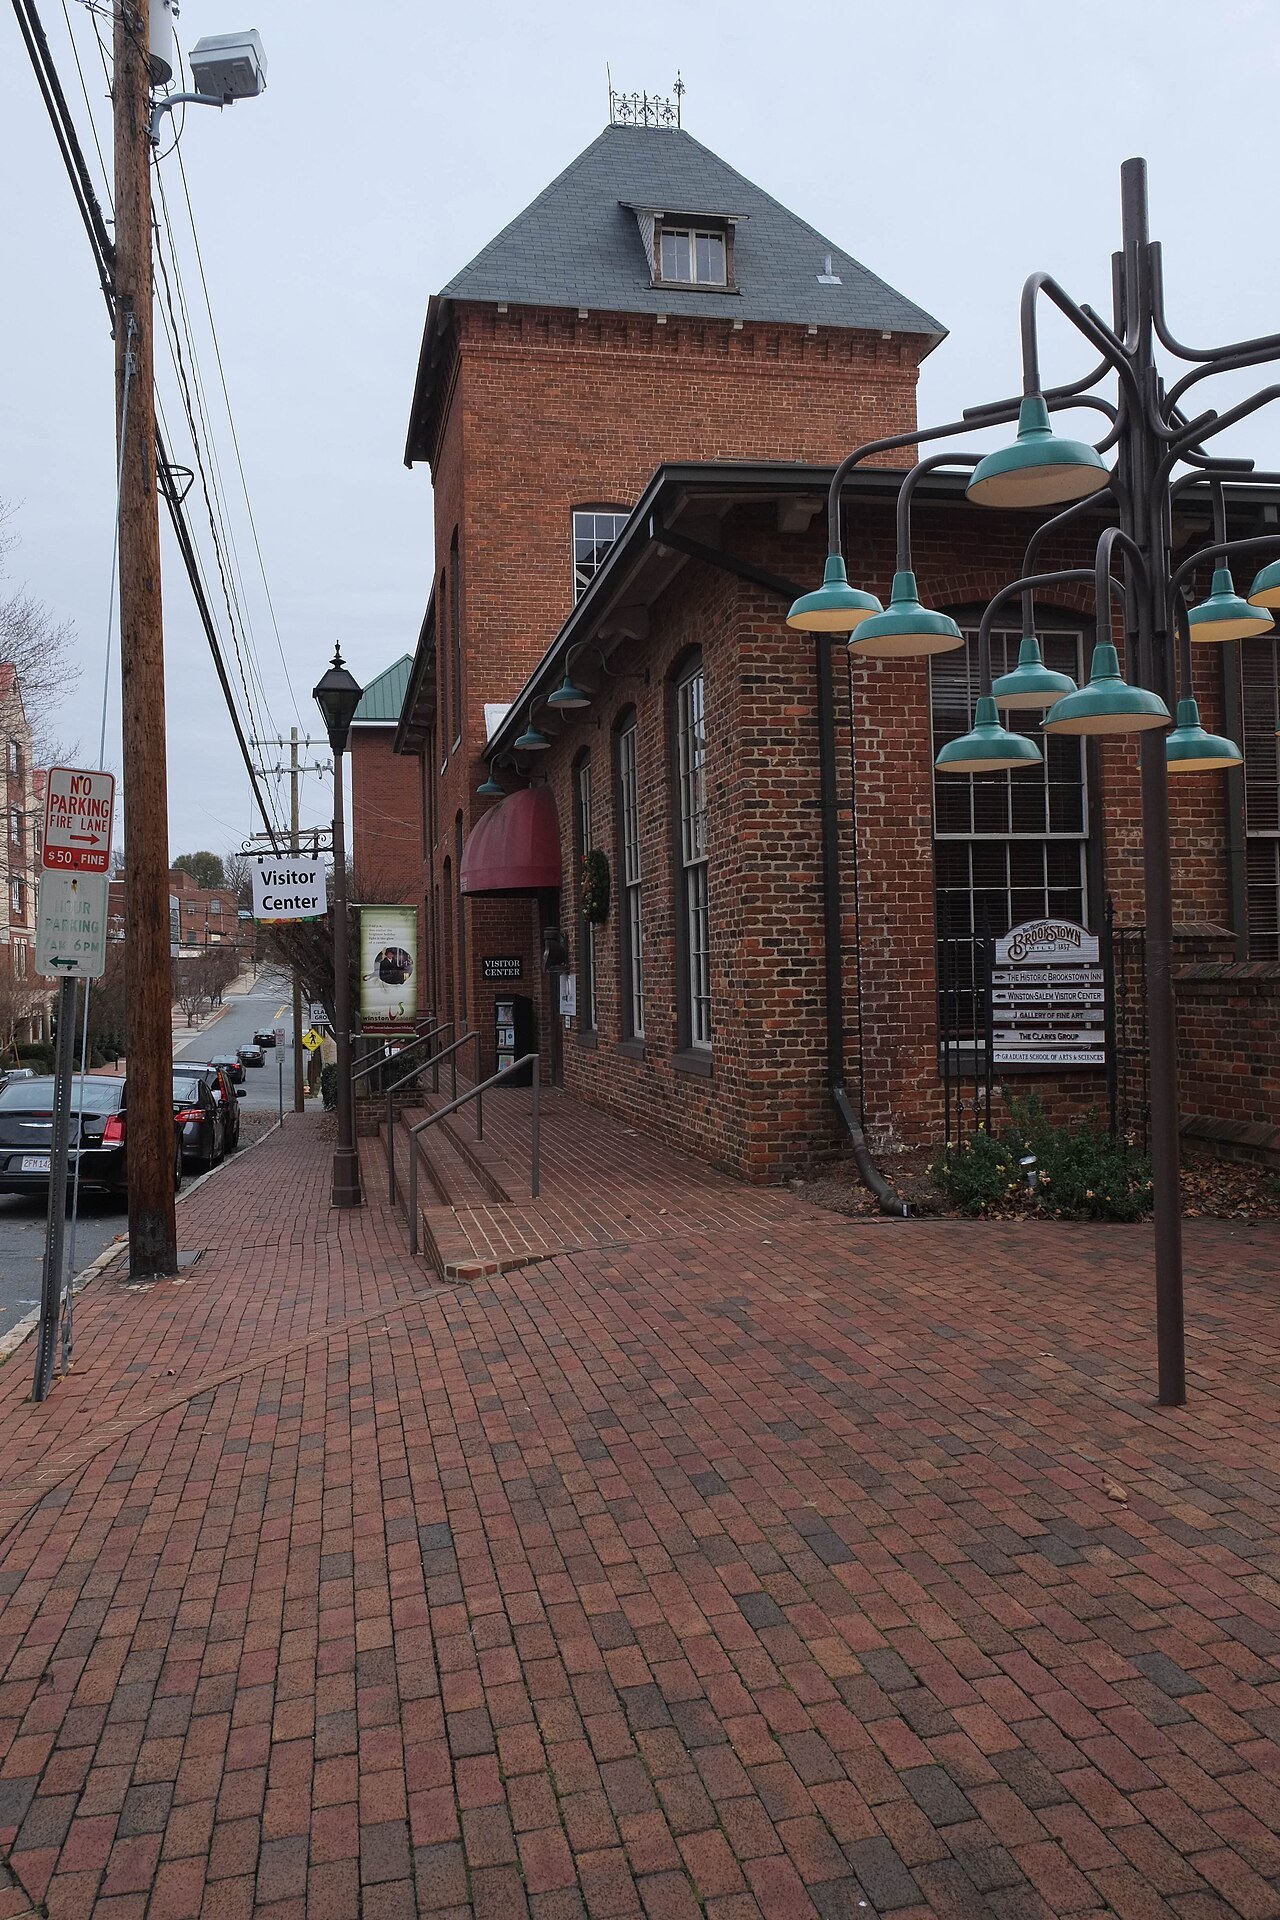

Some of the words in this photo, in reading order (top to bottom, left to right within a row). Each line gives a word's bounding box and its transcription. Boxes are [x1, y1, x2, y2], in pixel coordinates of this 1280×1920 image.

[70, 775, 92, 796] NO
[50, 793, 110, 819] PARKING
[49, 814, 73, 829] FIRE
[80, 817, 108, 833] LANE
[48, 850, 72, 864] $50
[80, 853, 105, 865] FINE
[260, 869, 317, 886] Visitor
[262, 895, 318, 911] Center
[45, 917, 99, 933] PARKING
[1008, 924, 1081, 961] BROOKSTOWN
[484, 959, 521, 968] VISITOR
[484, 968, 521, 977] CENTER
[1007, 972, 1020, 981] THE
[1020, 972, 1047, 981] HISTORIC
[1047, 972, 1090, 981] BROOKSTOWN
[1090, 972, 1102, 980] INN
[1007, 991, 1054, 1000] WINSTON-SALEM
[1054, 991, 1077, 1000] VISITOR
[1077, 991, 1102, 1000] CENTER
[1018, 1032, 1031, 1040] THE
[1032, 1032, 1057, 1040] CLARKS
[1057, 1032, 1080, 1040] GROUP
